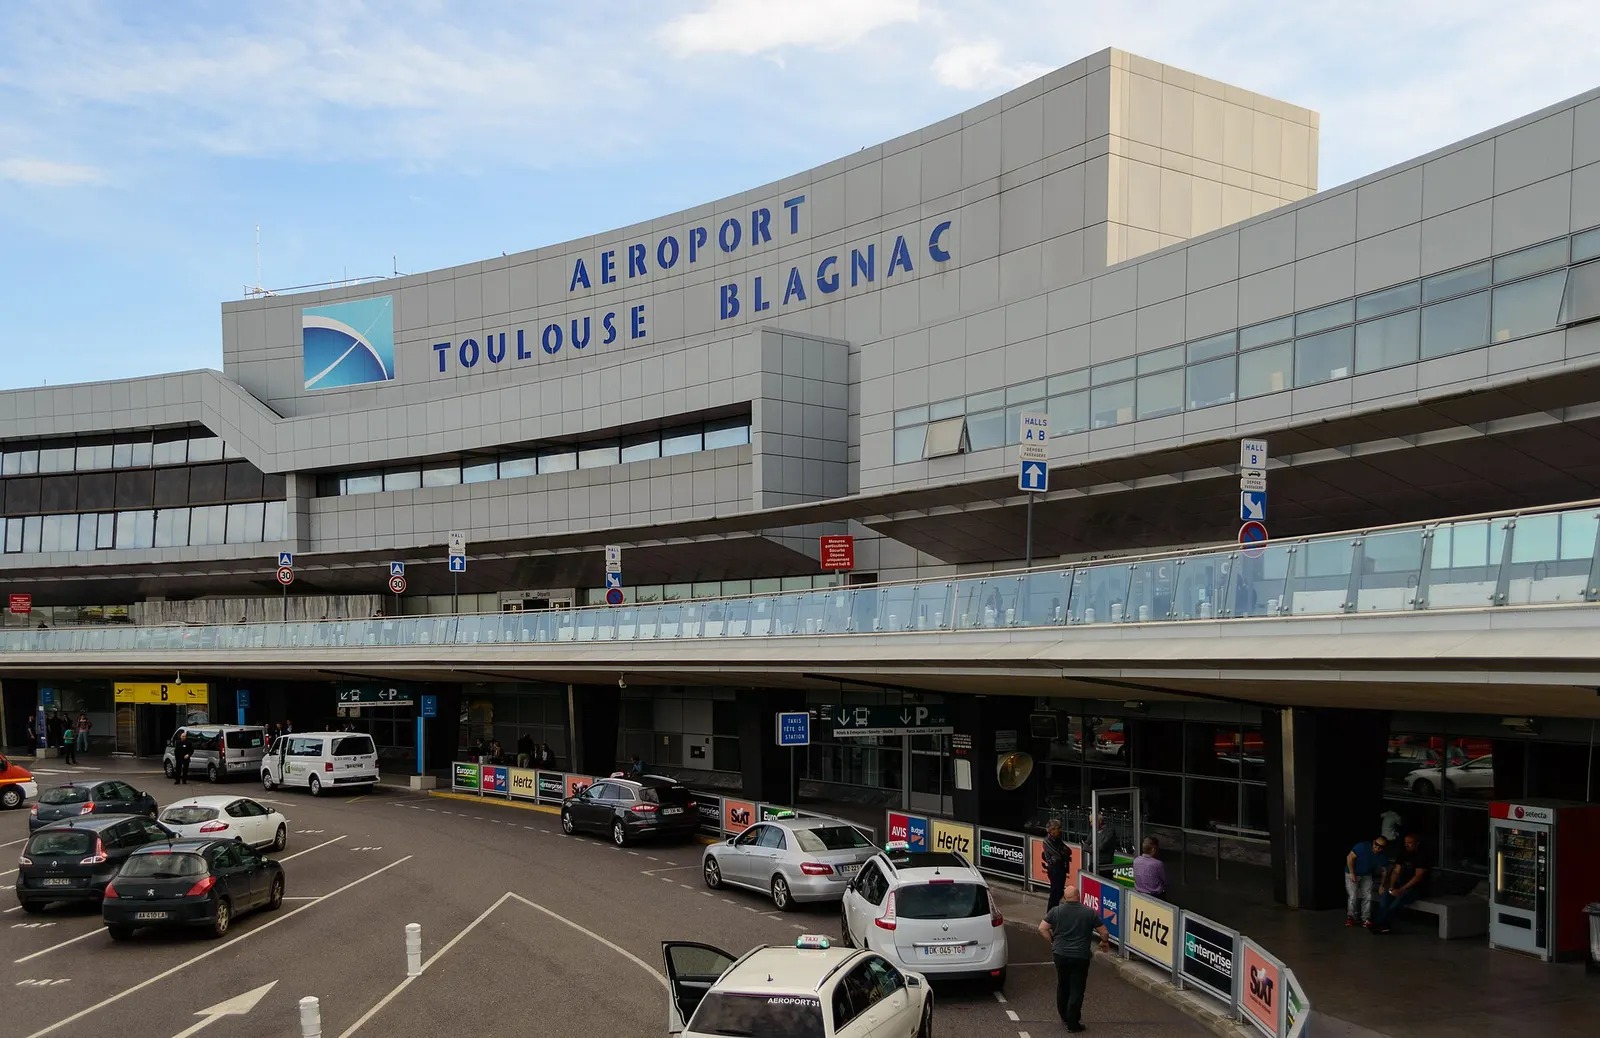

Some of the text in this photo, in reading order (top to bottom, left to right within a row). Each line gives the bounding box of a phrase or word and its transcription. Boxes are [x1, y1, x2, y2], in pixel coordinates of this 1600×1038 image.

[569, 194, 806, 292] AEROPORT
[432, 221, 952, 373] TOULOUSE BLAGNAC
[1024, 418, 1048, 426] HALLS
[1026, 429, 1045, 440] A B
[1252, 454, 1258, 464] B
[281, 571, 290, 580] 30
[393, 580, 402, 588] 30
[161, 684, 168, 700] B
[389, 688, 397, 700] P
[916, 707, 928, 725] P
[456, 766, 477, 776] Europcar
[513, 775, 533, 789] Hertz
[1525, 810, 1547, 819] selecta
[892, 826, 907, 837] AVIS
[937, 831, 970, 853] Hertz
[983, 844, 1023, 859] enterprise
[1084, 893, 1098, 910] AVIS
[1103, 896, 1117, 910] Budget
[1134, 908, 1170, 946] Hertz
[1187, 940, 1231, 969] enterprise
[767, 998, 811, 1006] AEROPORT
